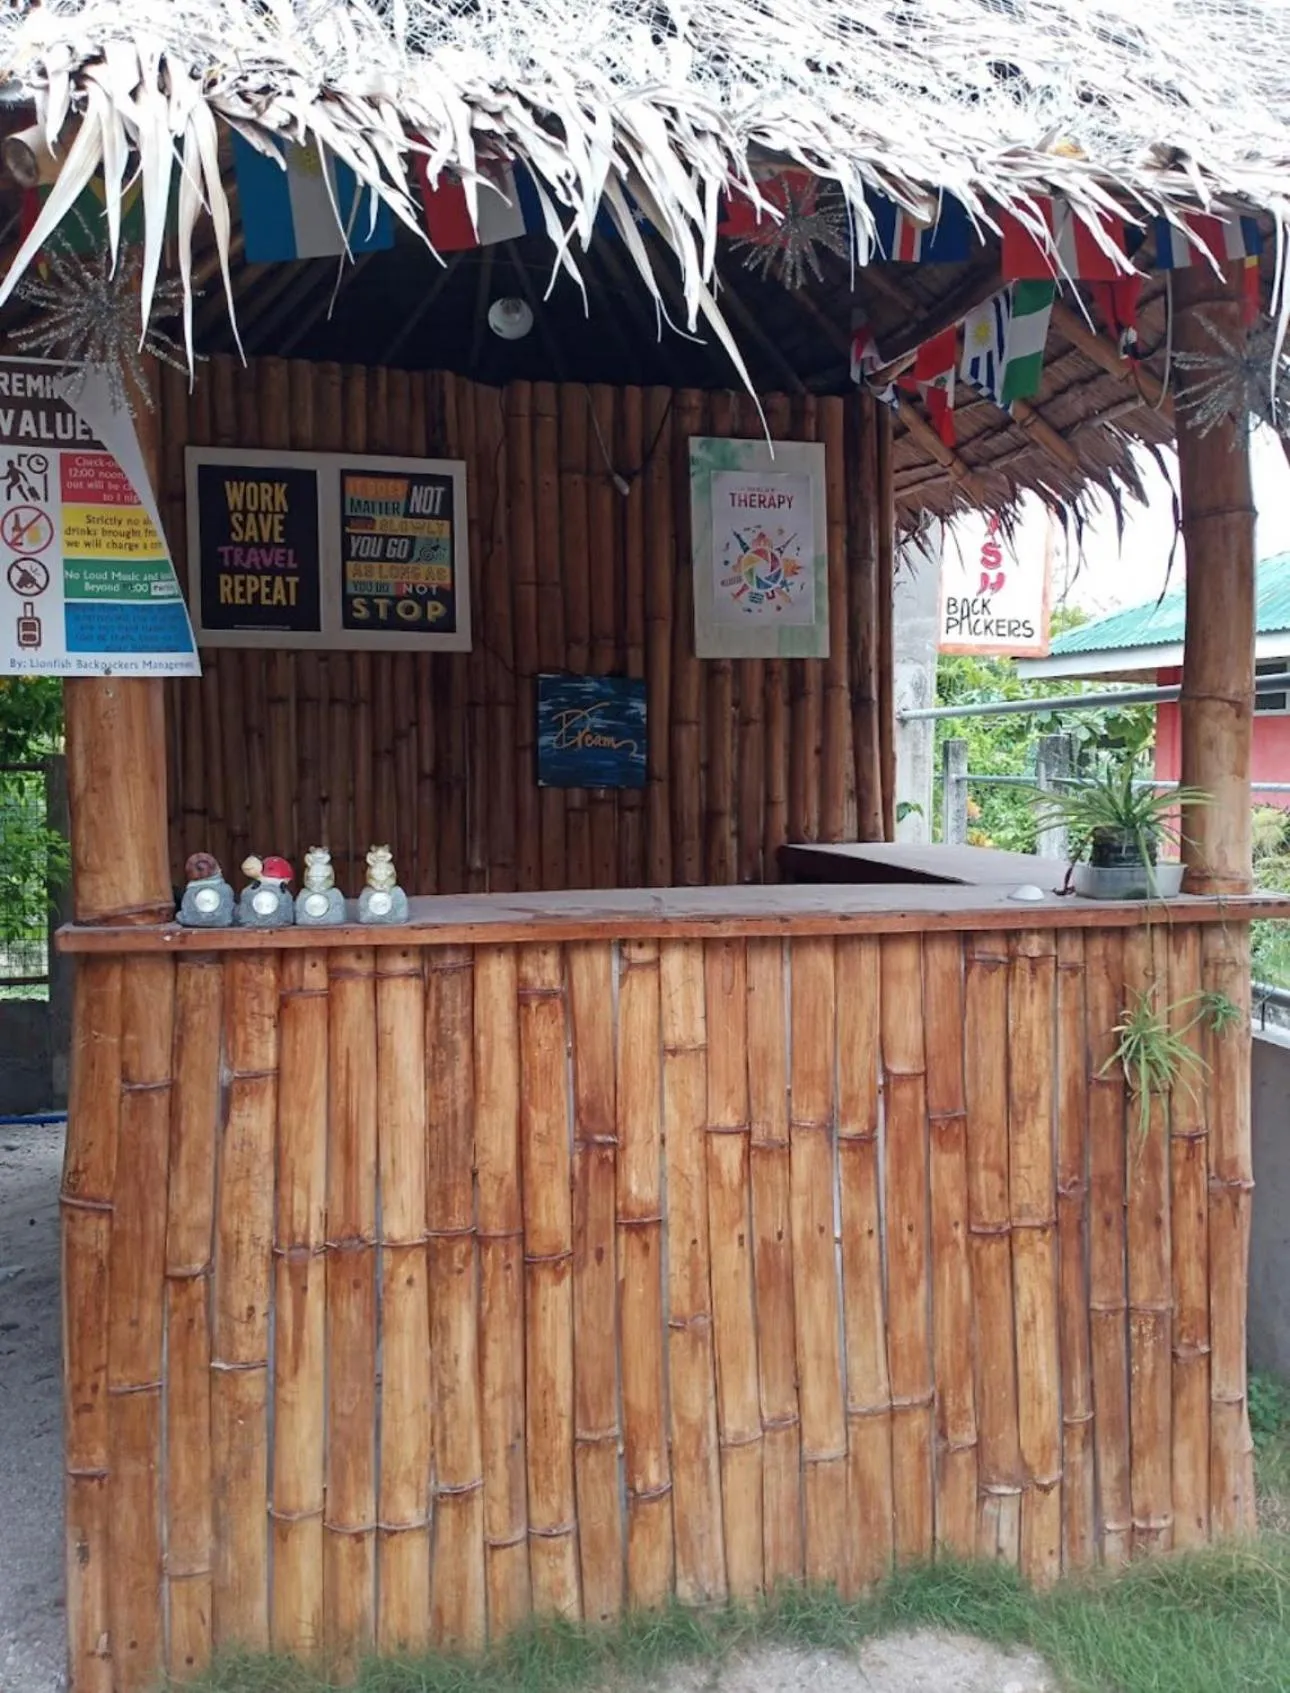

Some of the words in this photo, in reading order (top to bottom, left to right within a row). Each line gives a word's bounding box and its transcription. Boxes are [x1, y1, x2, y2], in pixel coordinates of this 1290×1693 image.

[224, 480, 289, 513] WORK
[350, 497, 401, 514] MATTER
[409, 485, 445, 514] NOT
[729, 492, 794, 510] THERAPY
[64, 526, 97, 537] drinks
[230, 512, 285, 543] SAVE
[217, 545, 298, 570] TRAVEL
[349, 535, 384, 558] YOU
[385, 537, 409, 559] GO
[64, 569, 80, 580] No
[83, 569, 108, 581] Loud
[111, 571, 140, 582] Music
[83, 581, 120, 593] Beyond
[218, 573, 300, 606] REPEAT
[402, 583, 439, 596] NOT
[351, 597, 448, 623] STOP
[946, 597, 992, 618] BACK
[946, 615, 1035, 638] PACKERS
[9, 658, 27, 669] By:
[29, 658, 72, 669] Lionfish
[75, 660, 139, 672] Backpackers
[551, 701, 638, 758] Dream
